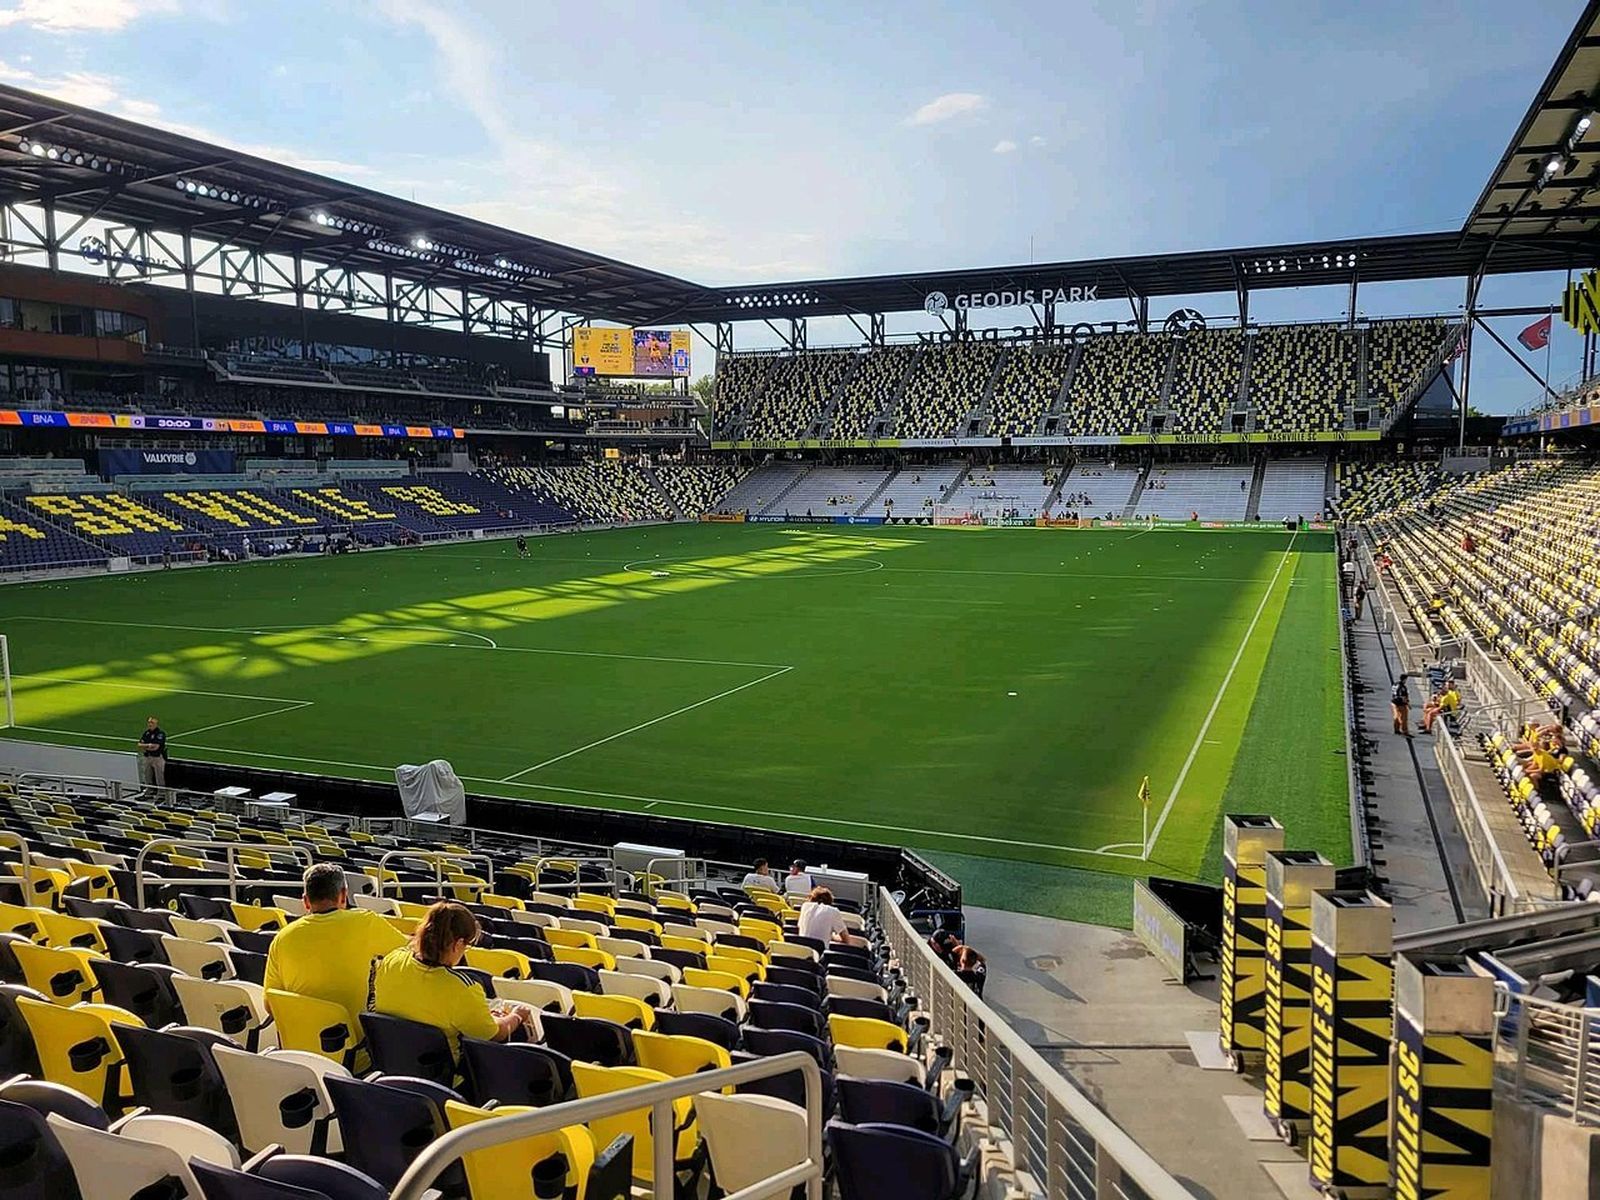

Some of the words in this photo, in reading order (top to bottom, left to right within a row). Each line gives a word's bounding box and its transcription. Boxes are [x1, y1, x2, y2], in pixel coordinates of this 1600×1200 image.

[954, 289, 1035, 311] GEODIS
[1042, 285, 1098, 305] PARK
[32, 414, 54, 424] BNA
[158, 419, 191, 428] 30:00
[272, 423, 288, 431] BNA
[1175, 434, 1211, 443] NASHVILLE
[1212, 434, 1222, 442] SC
[1267, 432, 1304, 441] NASHVILLE
[1308, 432, 1317, 441] SC
[143, 452, 184, 463] VALKYRIE
[987, 518, 1023, 526] Heineken
[1223, 876, 1236, 917] SC
[1266, 917, 1282, 962] SC
[1313, 965, 1334, 1016] SC
[1264, 960, 1282, 1117] NASHVILLE
[1398, 1040, 1420, 1102] SC
[1312, 1013, 1334, 1182] NASHVILLE
